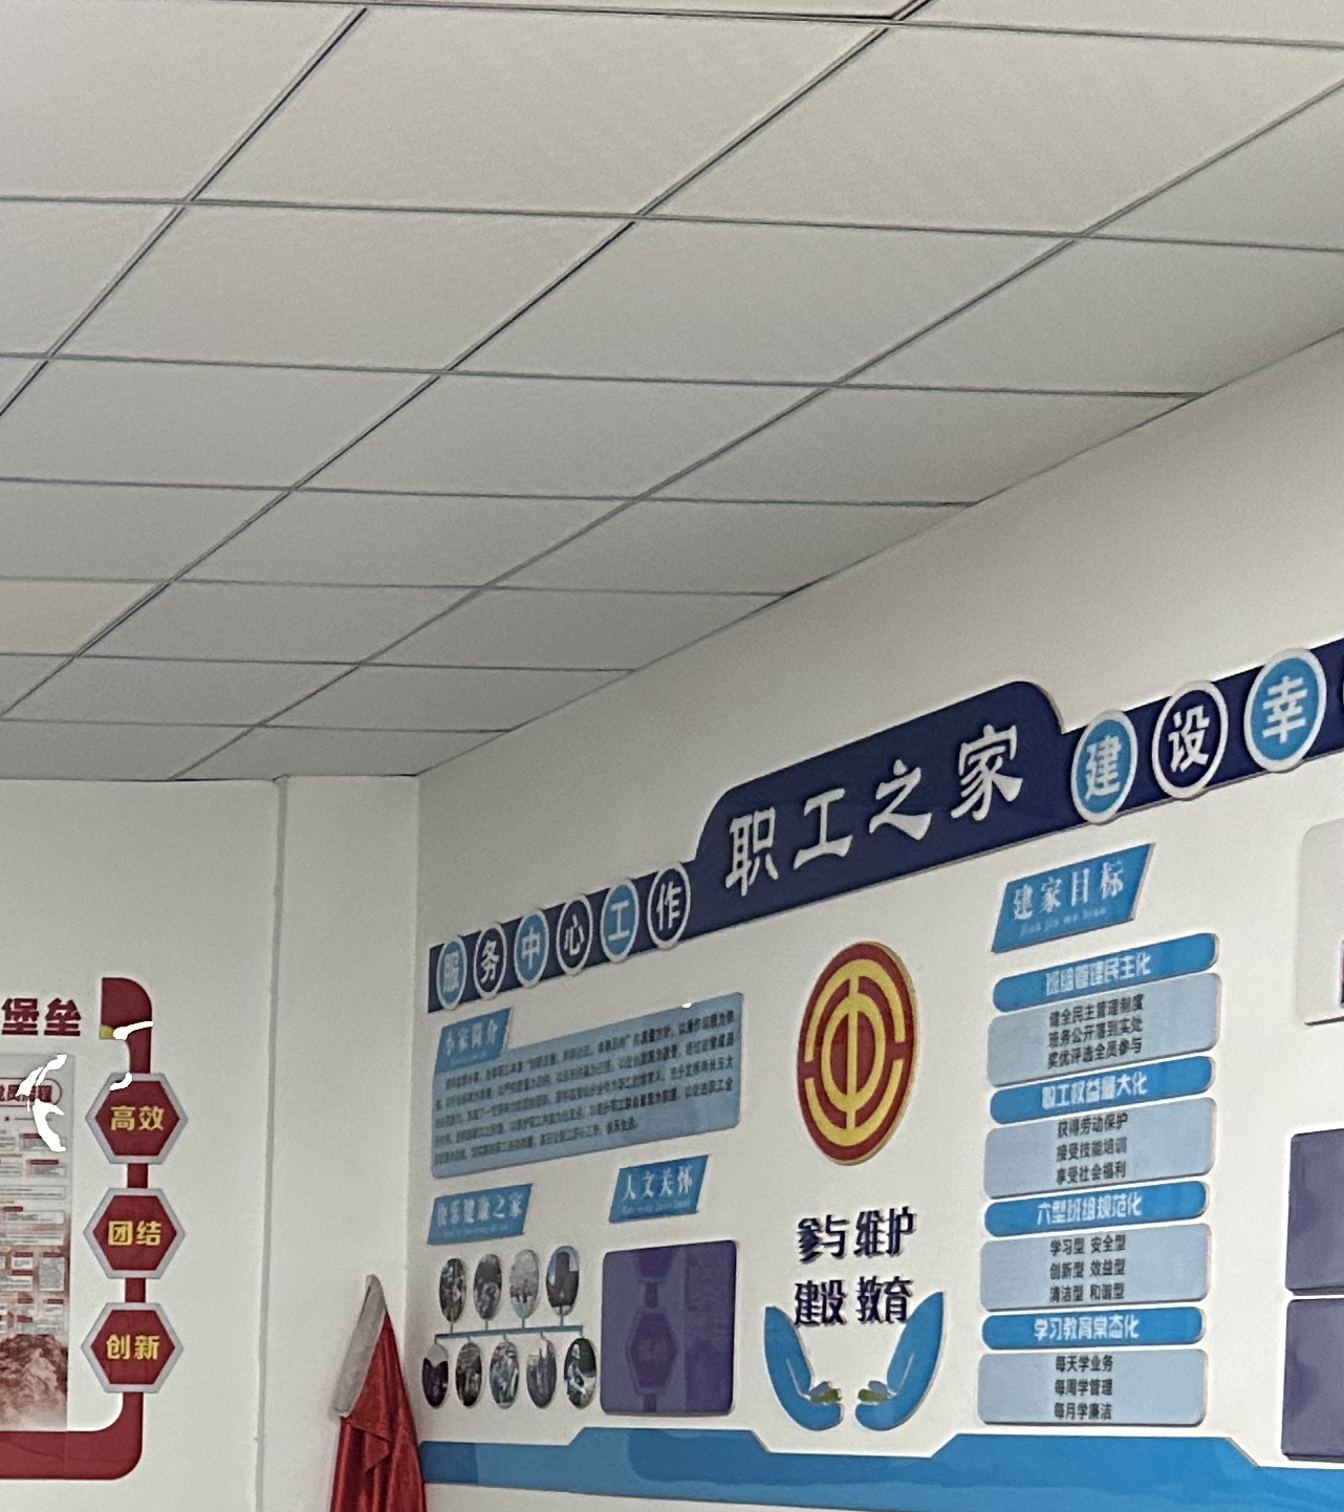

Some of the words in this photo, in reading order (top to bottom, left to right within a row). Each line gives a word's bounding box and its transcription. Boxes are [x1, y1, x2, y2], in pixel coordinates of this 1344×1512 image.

[725, 724, 1023, 896] 职工之家
[1013, 860, 1124, 920] 建家目标
[443, 881, 682, 993] 服务中心工作
[1046, 951, 1151, 997] 班组管理民主化
[1049, 993, 1144, 1028] 健全民主管理制度
[1047, 1037, 1143, 1070] 奖优评选全员参与
[1041, 1071, 1148, 1110] 职工权益最大化
[110, 1106, 164, 1132] 高效
[1057, 1112, 1128, 1139] 获得劳动保护
[1056, 1137, 1128, 1163] 接受技能培训
[1055, 1161, 1127, 1186] 享受社会福利
[1037, 1192, 1143, 1226] 六型班组规范化
[108, 1220, 162, 1246] 团结
[796, 1213, 849, 1264] 参与
[853, 1206, 917, 1258] 维护
[1050, 1237, 1085, 1257] 学习型
[1090, 1234, 1126, 1255] 安全型
[1050, 1261, 1085, 1281] 创新型
[1090, 1258, 1126, 1278] 效益型
[794, 1279, 848, 1327] 建设
[856, 1275, 914, 1325] 教育
[1049, 1286, 1085, 1304] 清洁型
[1090, 1283, 1125, 1301] 和谐型
[1033, 1314, 1140, 1342] 学习教育常态化
[106, 1335, 160, 1360] 创新
[1055, 1354, 1113, 1374] 每天学业务
[1054, 1378, 1113, 1397] 每周学管理
[1054, 1402, 1113, 1420] 每月学廉洁
